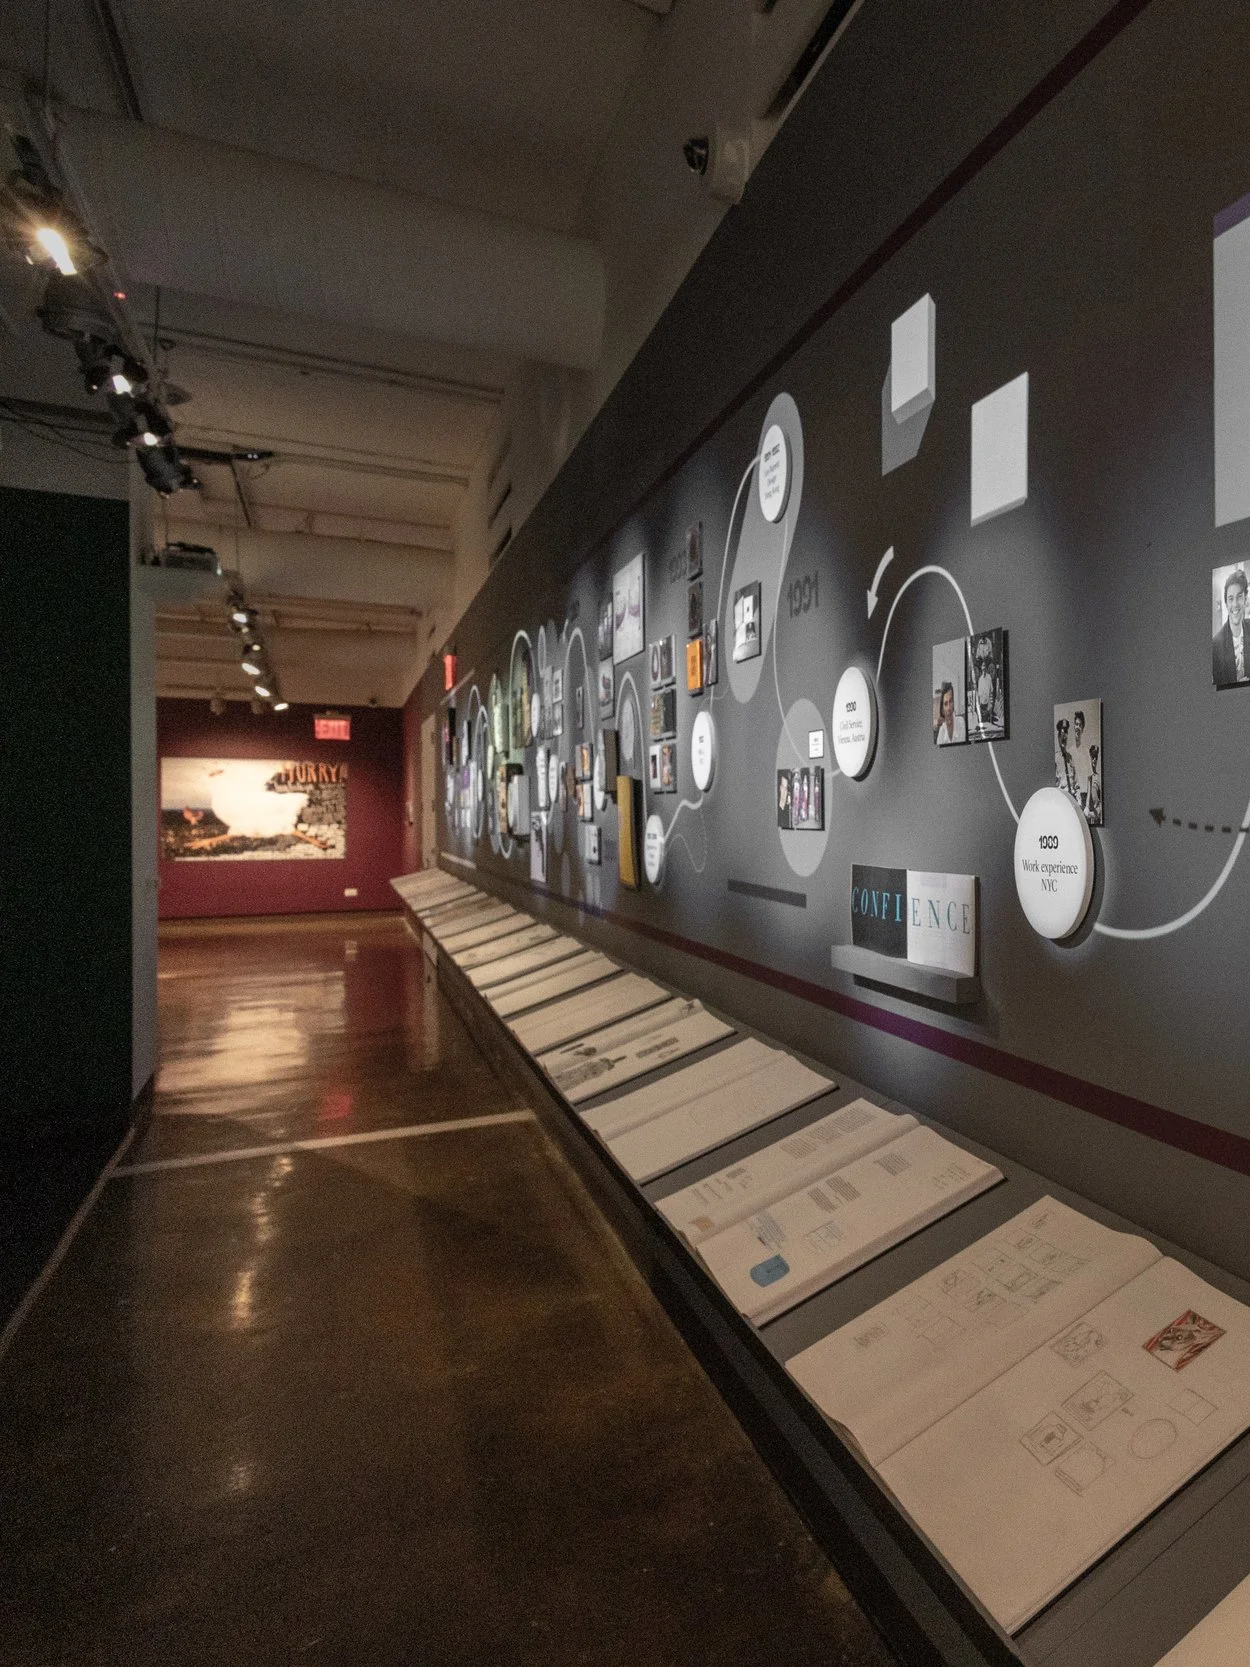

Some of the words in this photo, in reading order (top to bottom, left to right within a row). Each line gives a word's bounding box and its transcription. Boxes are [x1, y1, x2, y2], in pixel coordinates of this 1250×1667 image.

[1038, 835, 1059, 849] 1989
[1022, 859, 1039, 872] Work
[1041, 861, 1078, 877] experience
[1041, 879, 1058, 893] NYC
